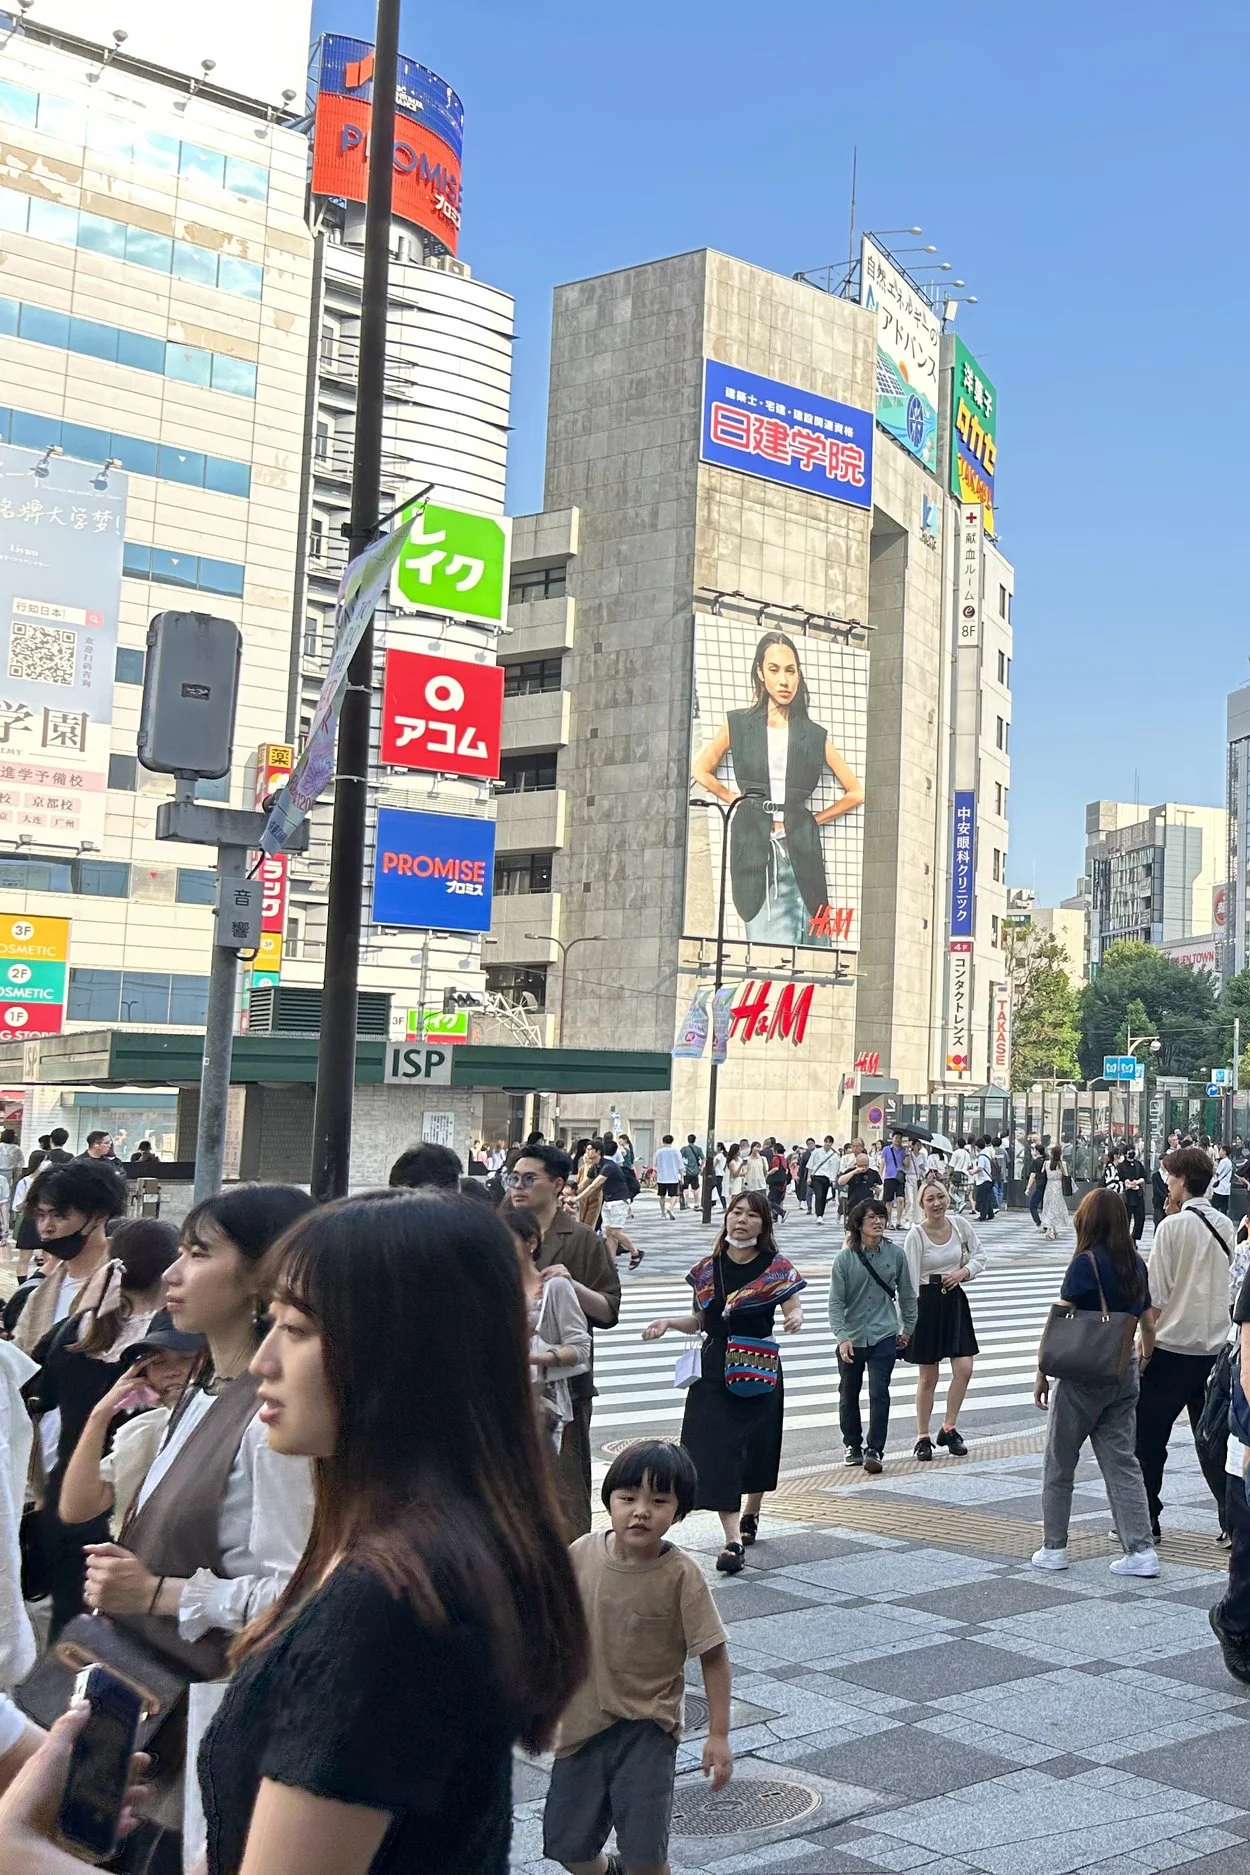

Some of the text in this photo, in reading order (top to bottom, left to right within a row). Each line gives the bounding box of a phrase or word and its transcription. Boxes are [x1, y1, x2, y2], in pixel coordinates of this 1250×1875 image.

[867, 255, 938, 347] 自然エネルギーの
[882, 306, 937, 384] アドバンス
[963, 361, 993, 419] 洋菓子
[710, 402, 866, 488] 日建学院
[956, 396, 998, 477] タカセ
[964, 532, 977, 601] 献血ルーム
[961, 625, 976, 638] 8F
[394, 716, 489, 760] アコム
[270, 748, 289, 767] 薬
[31, 796, 73, 811] 京都校
[383, 851, 486, 884] PROMISE
[956, 806, 971, 923] 中安眼科クリニック
[445, 881, 484, 897] プロミス
[15, 924, 32, 936] 3F
[233, 889, 252, 938] 音響
[808, 904, 854, 942] H&M
[954, 943, 968, 951] 4F
[12, 967, 28, 979] 2F
[9, 1010, 25, 1022] 1F
[729, 980, 814, 1044] H&M
[952, 958, 967, 1046] コンタクトレンズ
[392, 1017, 405, 1026] 3F
[996, 999, 1008, 1067] TAKASE
[391, 1048, 446, 1078] ISP
[855, 1051, 880, 1075] H&M
